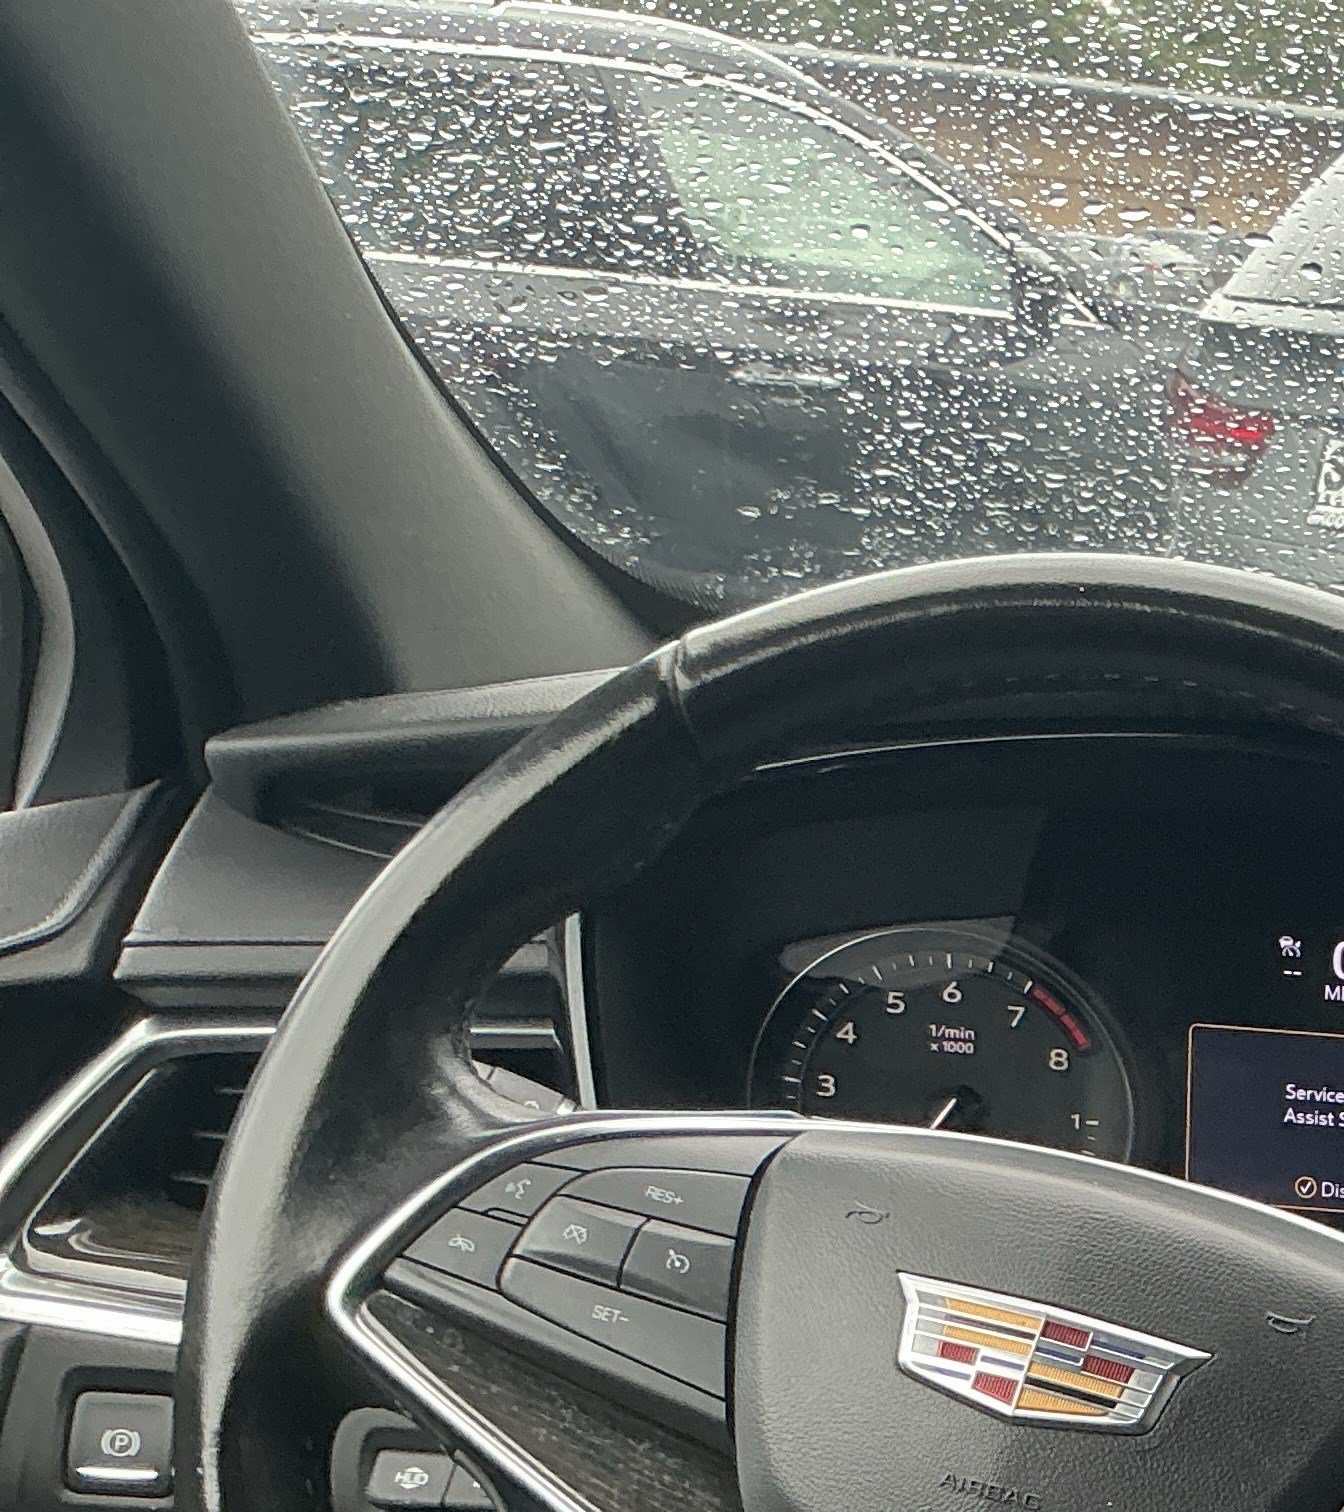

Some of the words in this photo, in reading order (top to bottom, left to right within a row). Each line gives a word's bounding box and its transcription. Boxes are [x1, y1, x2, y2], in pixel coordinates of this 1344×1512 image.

[886, 991, 905, 1014] 5
[943, 981, 962, 1004] 6
[1007, 1006, 1025, 1029] 7
[836, 1022, 858, 1045] 4
[929, 1024, 975, 1041] 1/min
[942, 1040, 975, 1054] 1000
[1048, 1049, 1069, 1072] 8
[816, 1075, 836, 1098] 3
[1283, 1107, 1336, 1128] Assist
[933, 1472, 1041, 1512] AIRBAG
